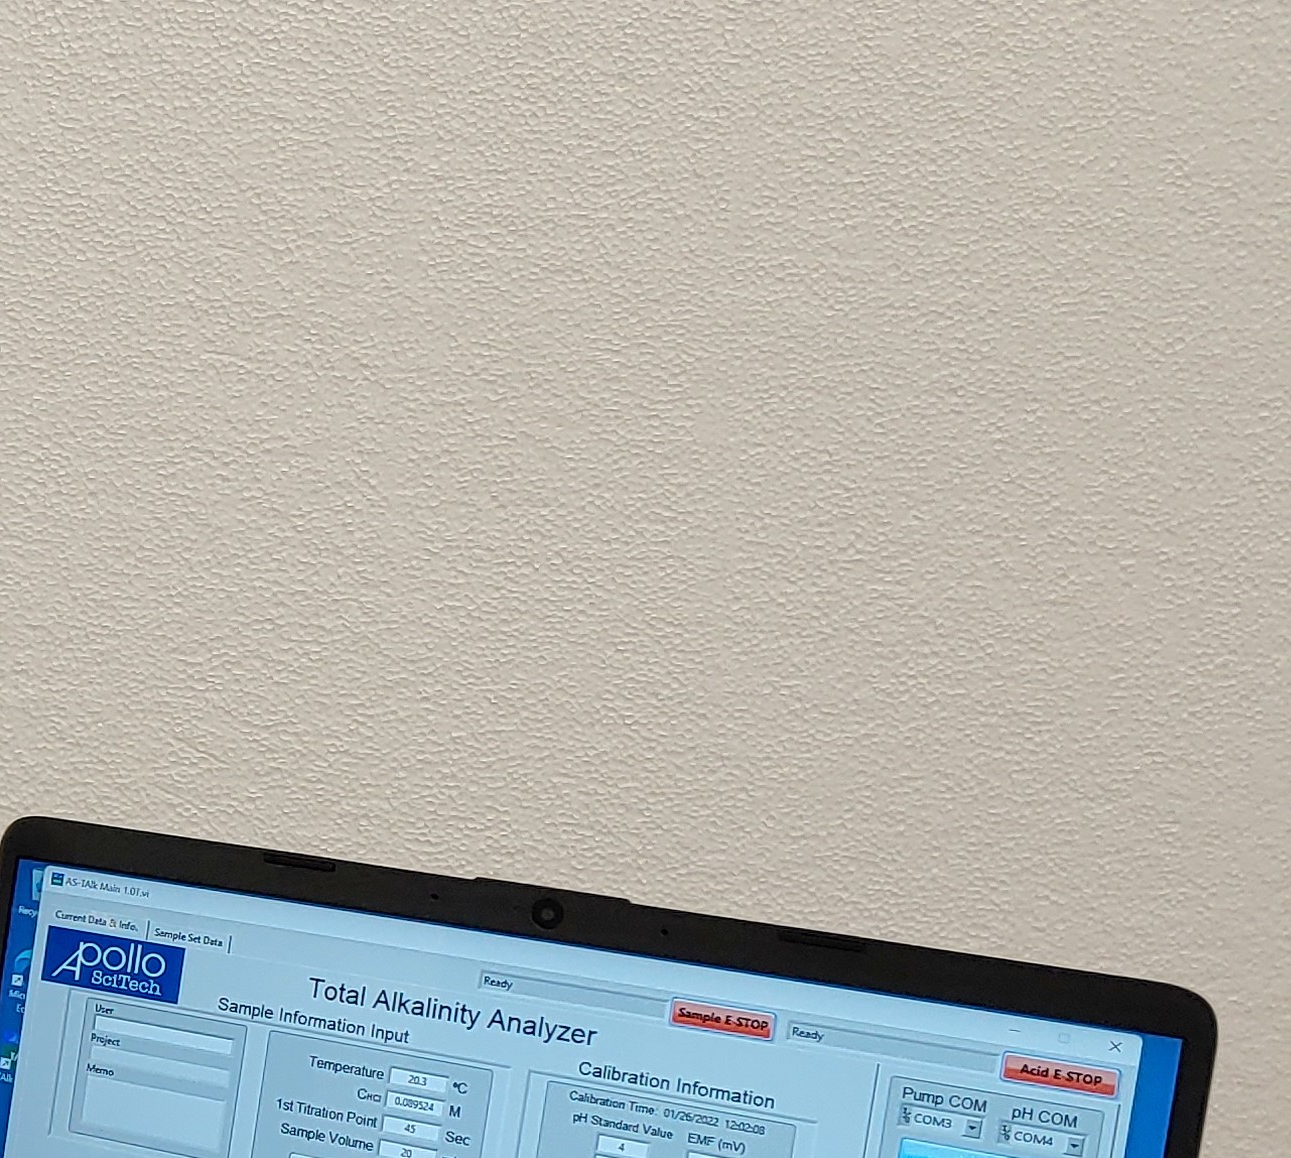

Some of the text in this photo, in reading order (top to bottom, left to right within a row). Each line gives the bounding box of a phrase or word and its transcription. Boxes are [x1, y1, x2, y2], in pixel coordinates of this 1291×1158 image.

[55, 910, 106, 926] Current Data
[154, 927, 223, 947] Sample Set Data
[51, 941, 166, 981] Apollo
[91, 970, 162, 996] SciTech
[484, 976, 513, 991] Ready
[95, 1004, 114, 1014] User
[310, 976, 598, 1046] Total Alkalinity Analyzer
[678, 1007, 722, 1024] Sample
[218, 997, 410, 1044] Sample Information Input
[91, 1032, 120, 1047] Project
[792, 1026, 824, 1042] Ready
[86, 1062, 114, 1076] Memo
[310, 1055, 384, 1082] Temperature
[1020, 1062, 1050, 1078] Acid
[578, 1061, 776, 1110] Calibration Information
[570, 1090, 626, 1110] Calibration
[902, 1086, 988, 1113] Pump COM
[449, 1105, 462, 1119] M
[914, 1112, 953, 1130] COM3
[1012, 1106, 1078, 1128] pH COM
[276, 1098, 472, 1148] 1st Titration Point 45 Sec
[572, 1112, 674, 1140] pH Standard Value
[280, 1122, 326, 1144] Sample
[329, 1132, 374, 1152] Volume
[400, 1147, 413, 1158] 20
[688, 1132, 746, 1156] EMF (mV)
[1014, 1130, 1054, 1146] COM4
